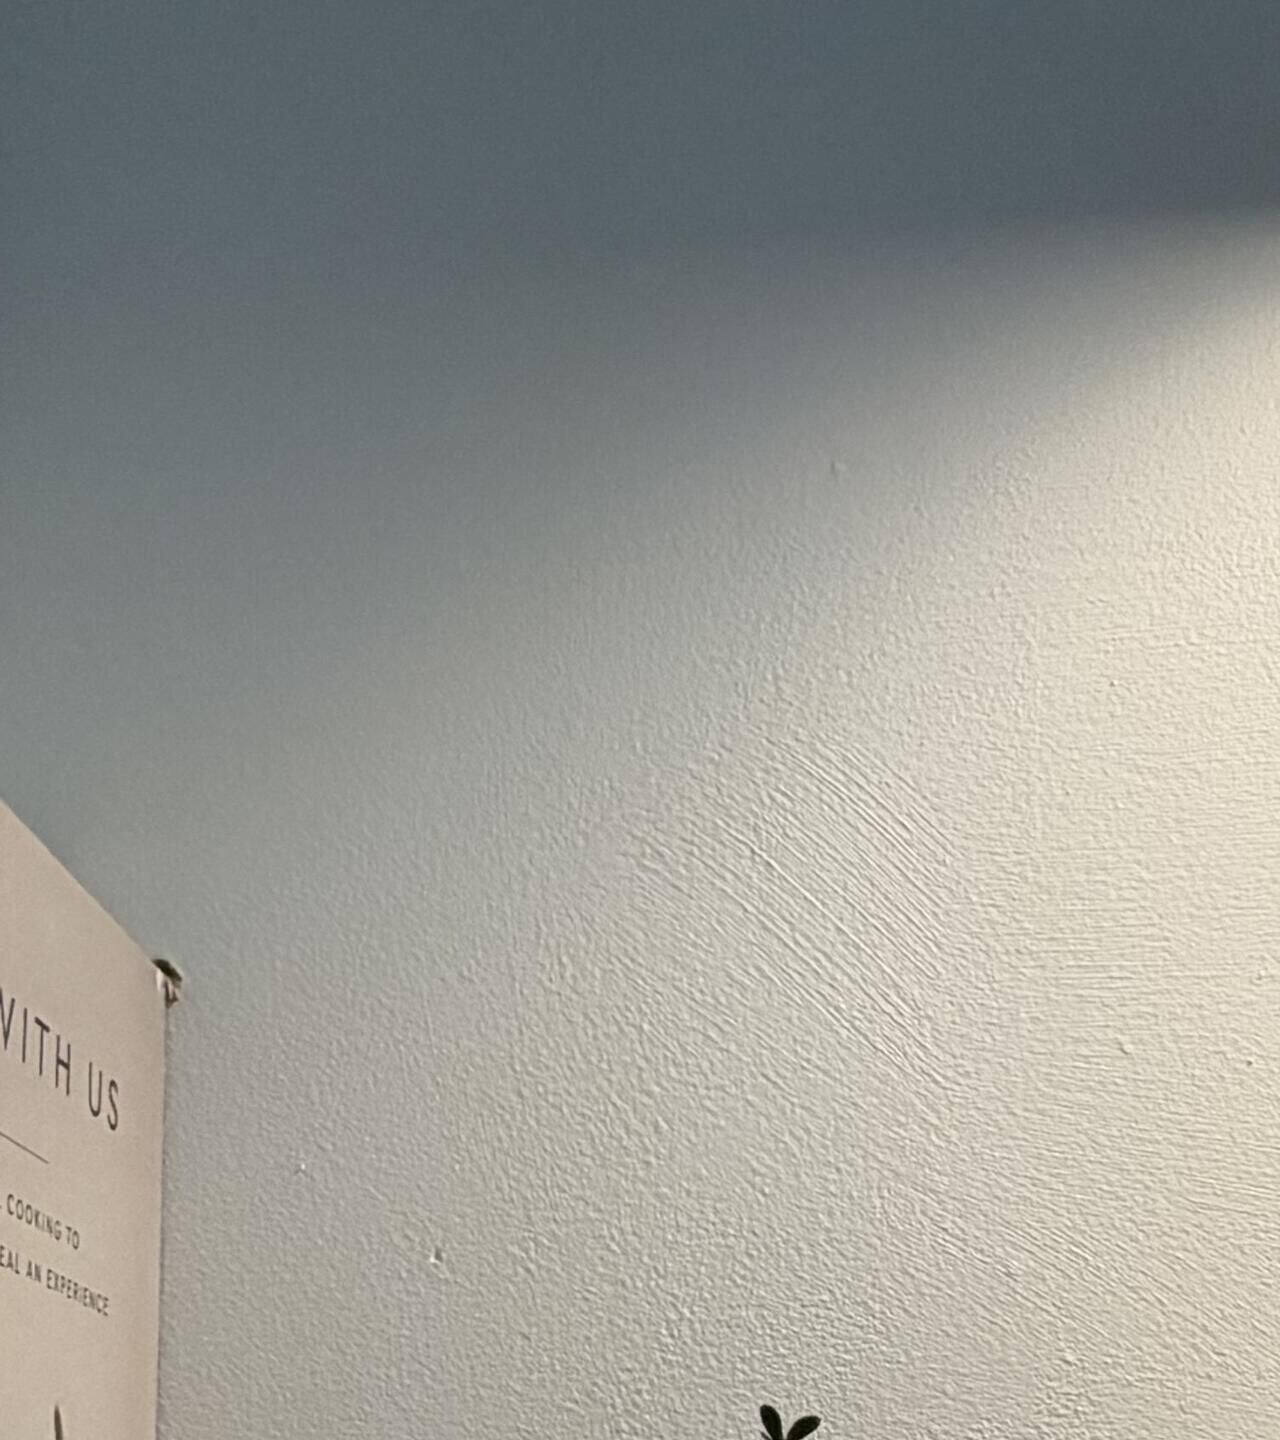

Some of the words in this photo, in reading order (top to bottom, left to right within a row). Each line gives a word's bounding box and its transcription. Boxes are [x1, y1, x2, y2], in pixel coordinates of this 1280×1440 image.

[88, 1061, 120, 1131] US
[6, 1194, 61, 1240] COOKING
[66, 1225, 80, 1250] TO
[26, 1260, 42, 1282] AN
[46, 1269, 109, 1317] EXPERIENCE
